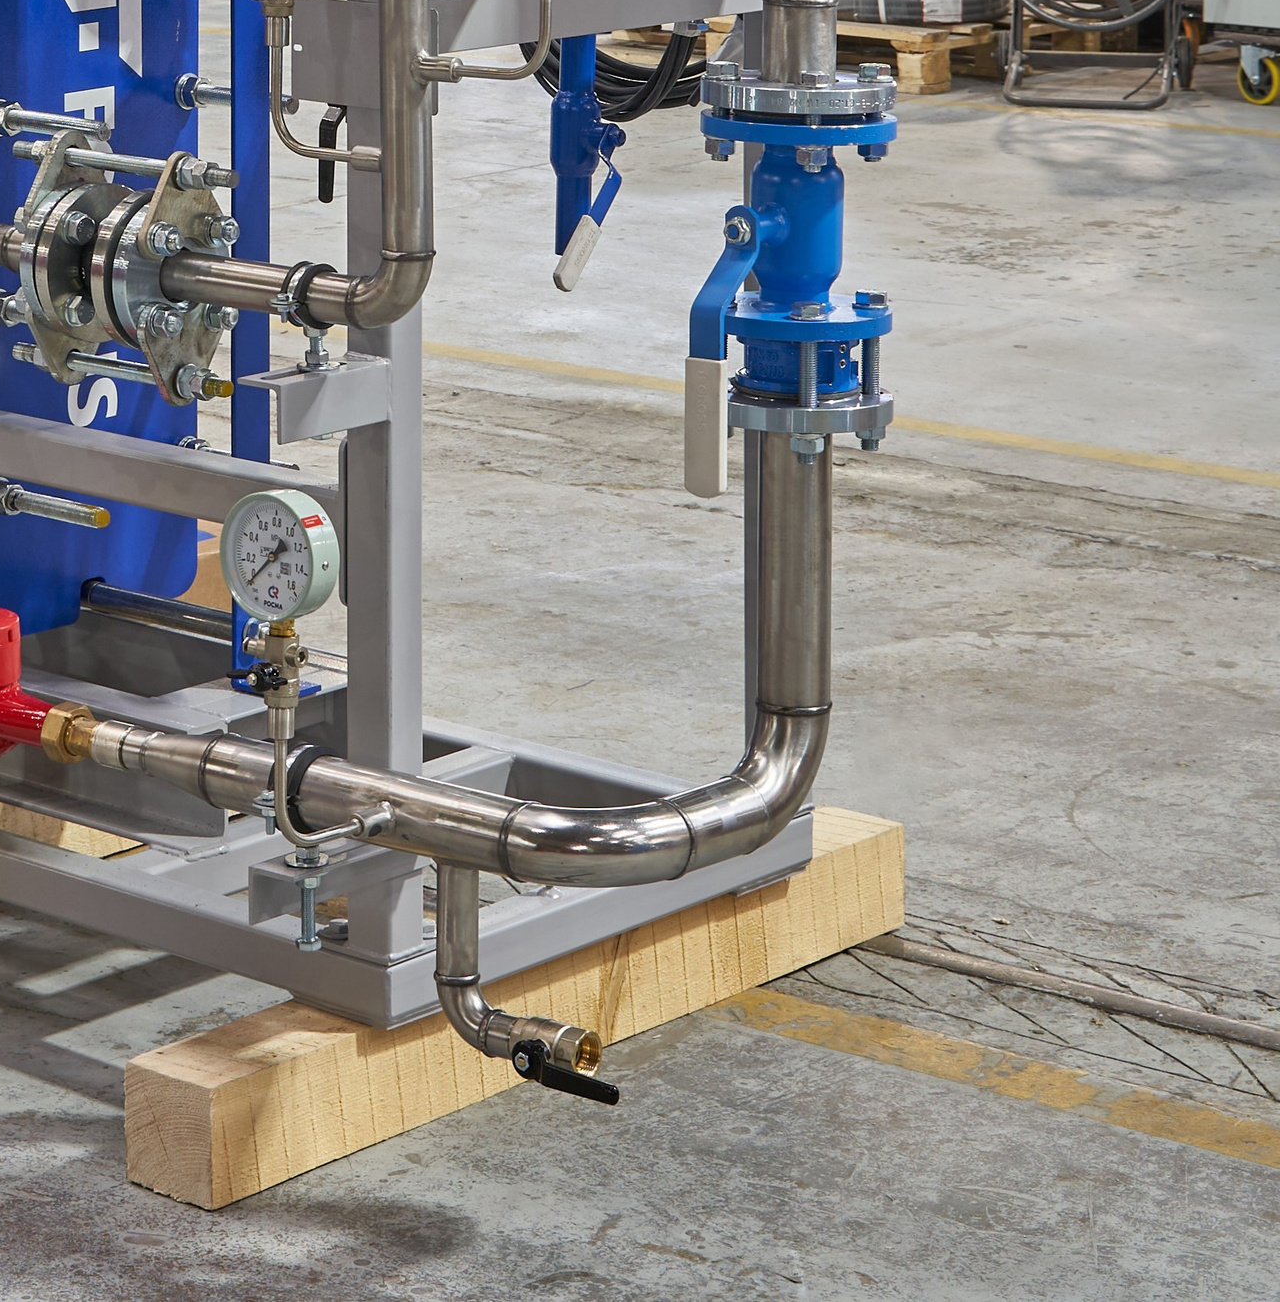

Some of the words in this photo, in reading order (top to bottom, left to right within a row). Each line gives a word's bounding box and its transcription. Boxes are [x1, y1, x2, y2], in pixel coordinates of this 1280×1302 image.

[259, 520, 268, 531] 0,6
[272, 517, 282, 528] 0,8
[249, 532, 259, 543] 0,4
[286, 527, 295, 537] 1,0
[294, 542, 303, 553] 1,2
[246, 552, 256, 563] 0,2
[295, 563, 304, 574] 1,4
[287, 580, 296, 591] 1,6
[263, 600, 283, 610] РОСМА
